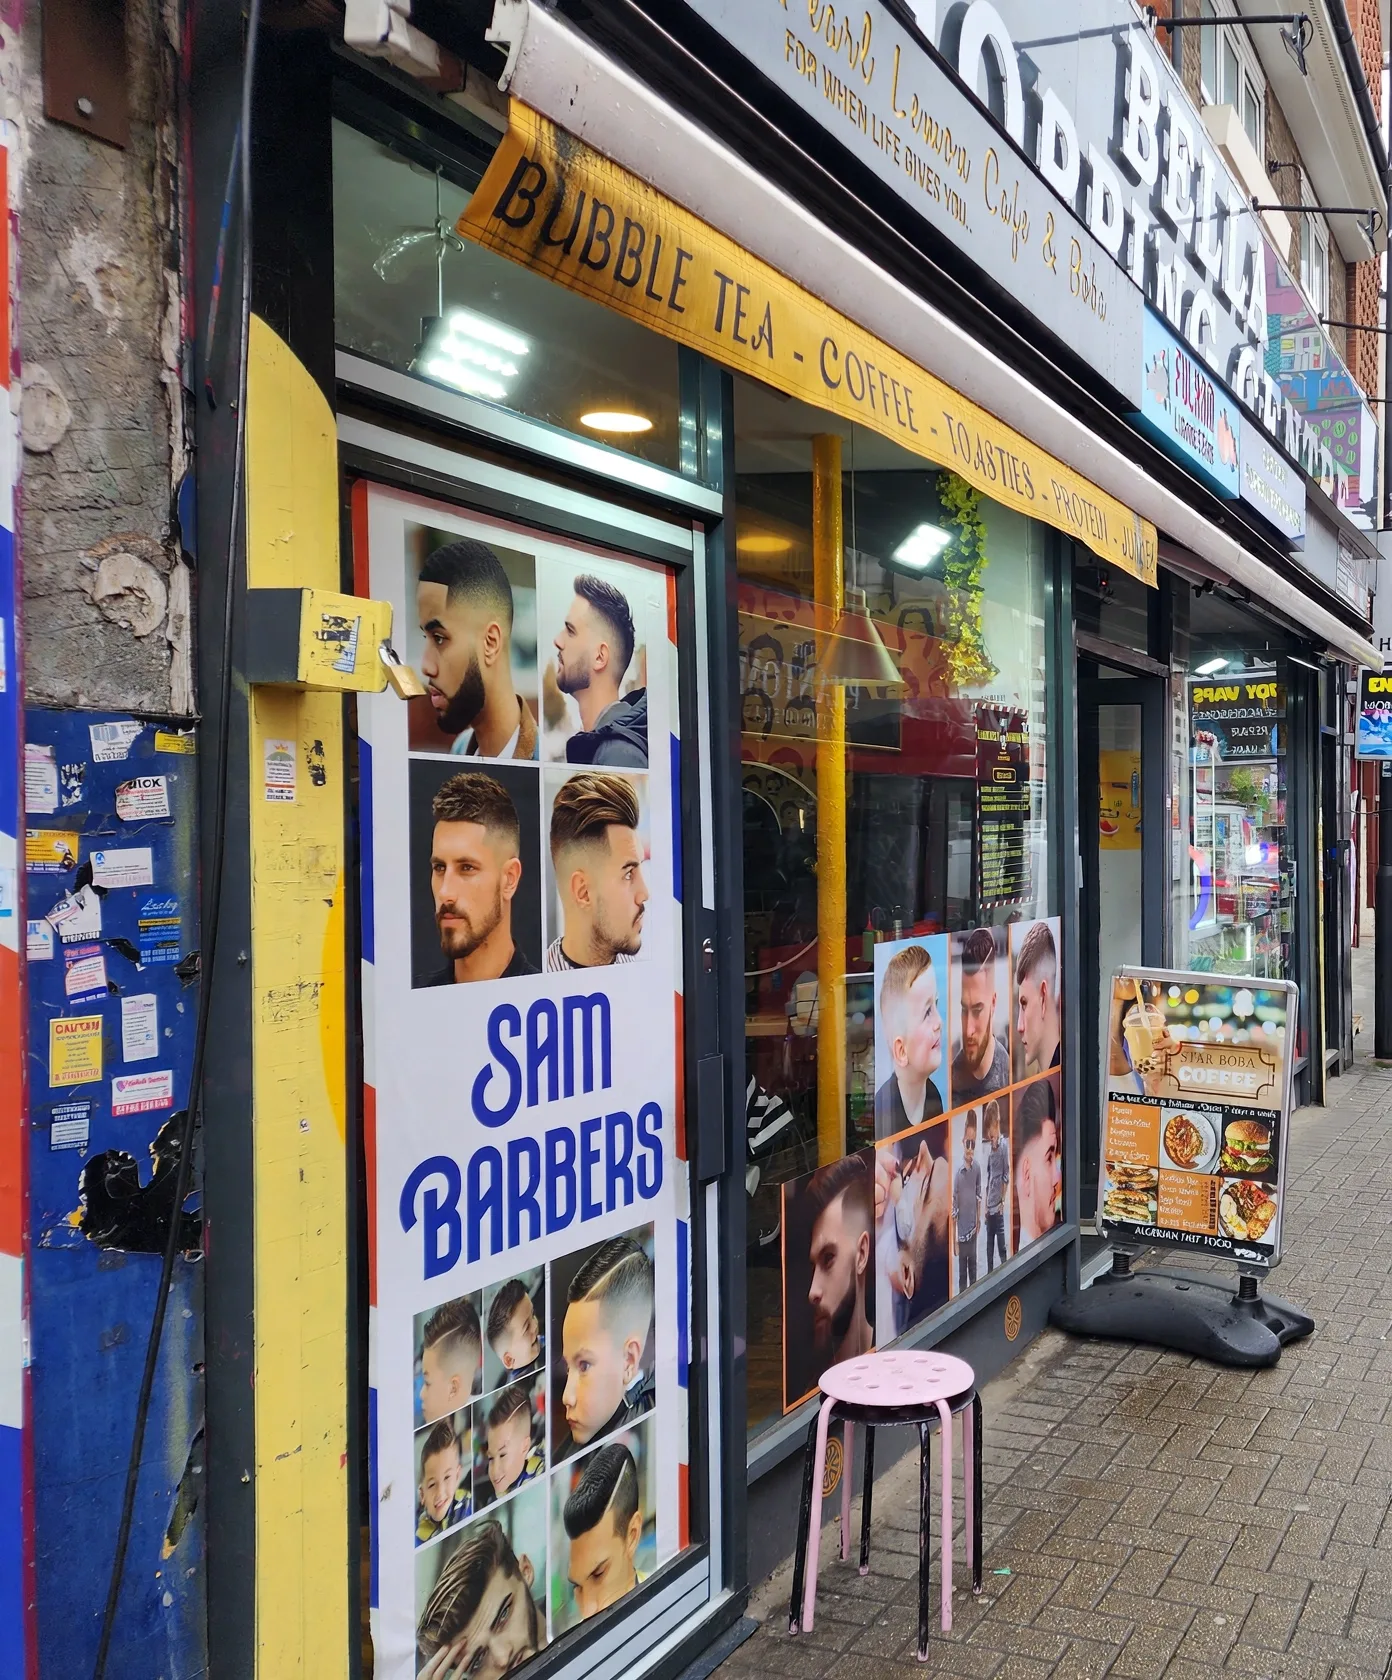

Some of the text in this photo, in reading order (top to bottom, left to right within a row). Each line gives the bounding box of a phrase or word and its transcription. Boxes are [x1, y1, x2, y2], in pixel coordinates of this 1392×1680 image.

[778, 0, 875, 85] earl
[891, 44, 971, 184] Lemon
[1042, 211, 1057, 275] &
[1070, 236, 1107, 322] Boba
[785, 28, 818, 88] FOR
[823, 64, 867, 136] WHEN
[872, 113, 901, 166] LIFE
[905, 146, 940, 202] GIVES
[492, 155, 693, 314] BUBBLE
[713, 269, 774, 359] TEA
[820, 336, 919, 434] COFFEE
[942, 410, 1035, 501] TOASTIES
[471, 992, 612, 1128] SAM
[1178, 1066, 1257, 1088] COFFEE
[1180, 1052, 1256, 1068] STAR BOBA
[399, 1101, 663, 1281] BARBERS
